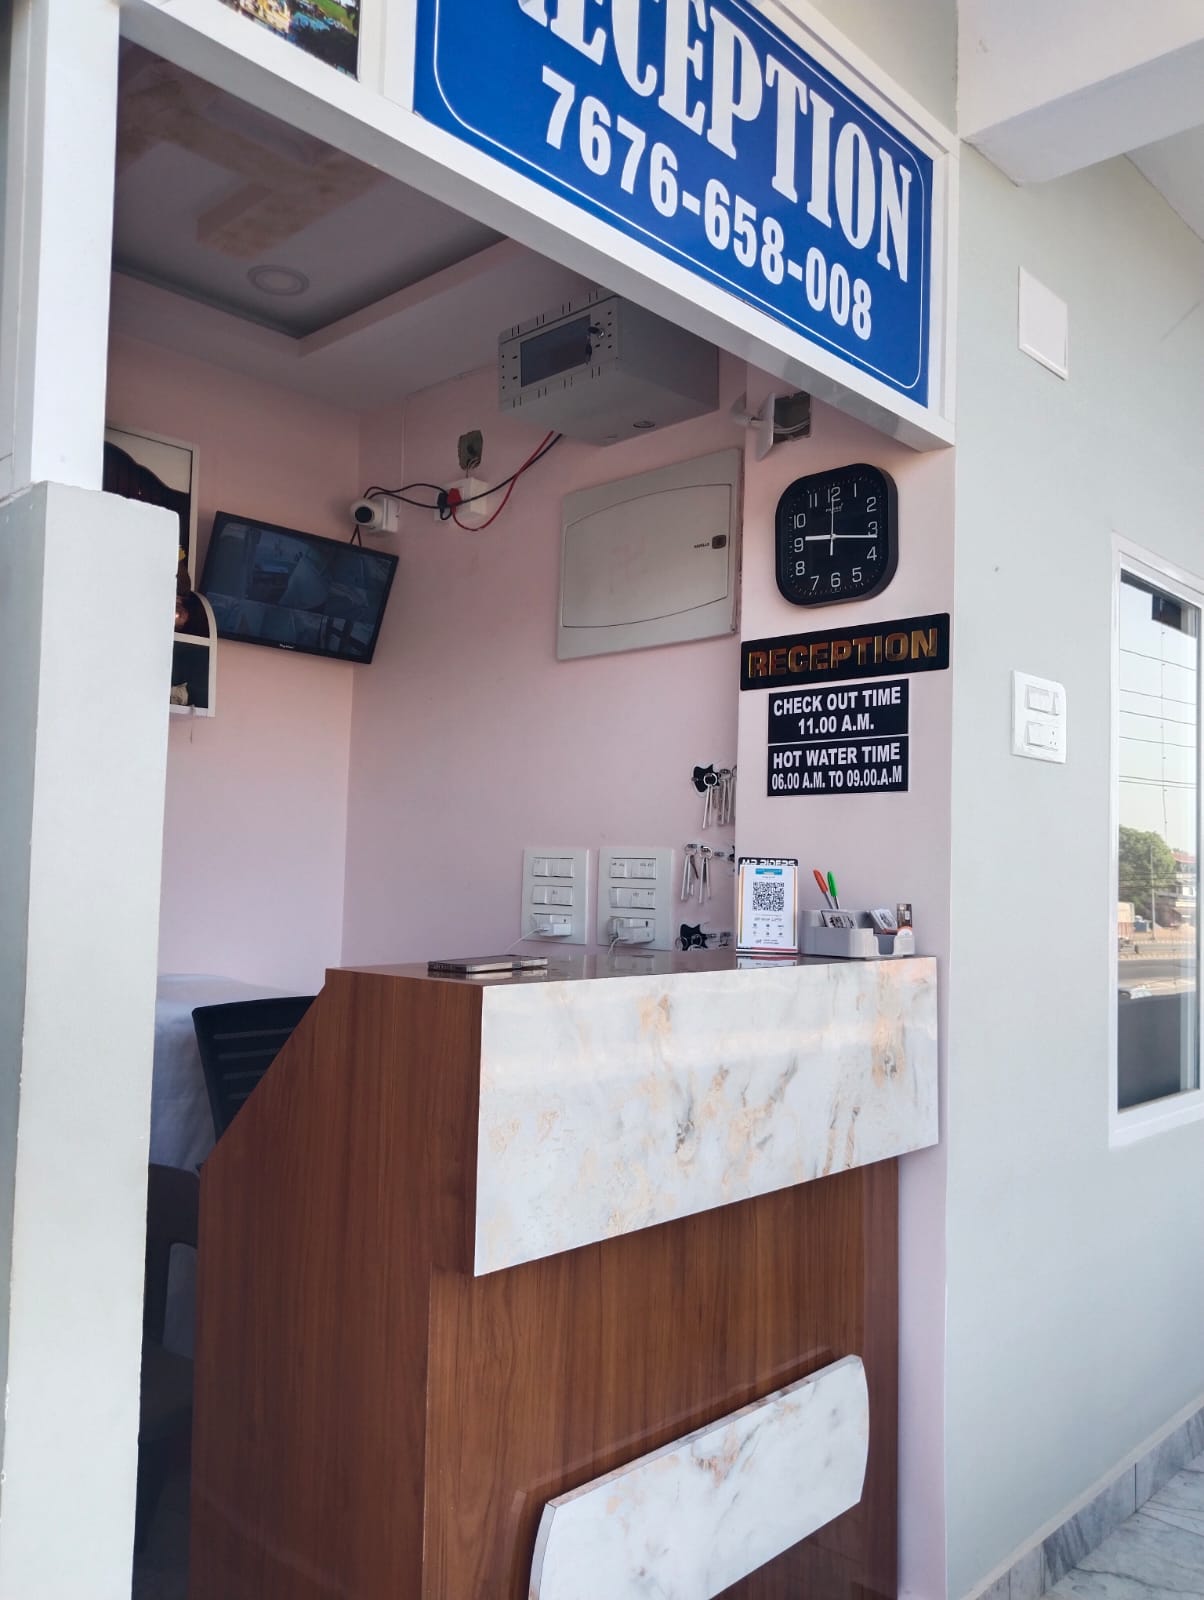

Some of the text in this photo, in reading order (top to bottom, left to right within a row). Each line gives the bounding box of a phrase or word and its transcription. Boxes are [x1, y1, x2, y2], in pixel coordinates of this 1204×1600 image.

[542, 65, 872, 341] 7676-658-008
[828, 487, 841, 503] 12
[853, 483, 857, 498] 1
[809, 493, 818, 508] 11
[866, 496, 877, 512] 2
[793, 513, 806, 529] 10
[867, 521, 878, 537] 3
[794, 537, 804, 552] 9
[866, 546, 877, 561] 4
[795, 561, 805, 576] 8
[852, 566, 862, 583] 5
[810, 575, 819, 591] 7
[830, 572, 841, 588] 6
[748, 627, 938, 679] RECEPTION
[773, 686, 901, 716] CHECK OUT TIME
[798, 713, 875, 735] 11.00 A.M.
[773, 742, 900, 769] HOT WATER TIME
[771, 772, 800, 790] 06.00
[802, 772, 826, 789] A.M.
[828, 770, 844, 788] TO
